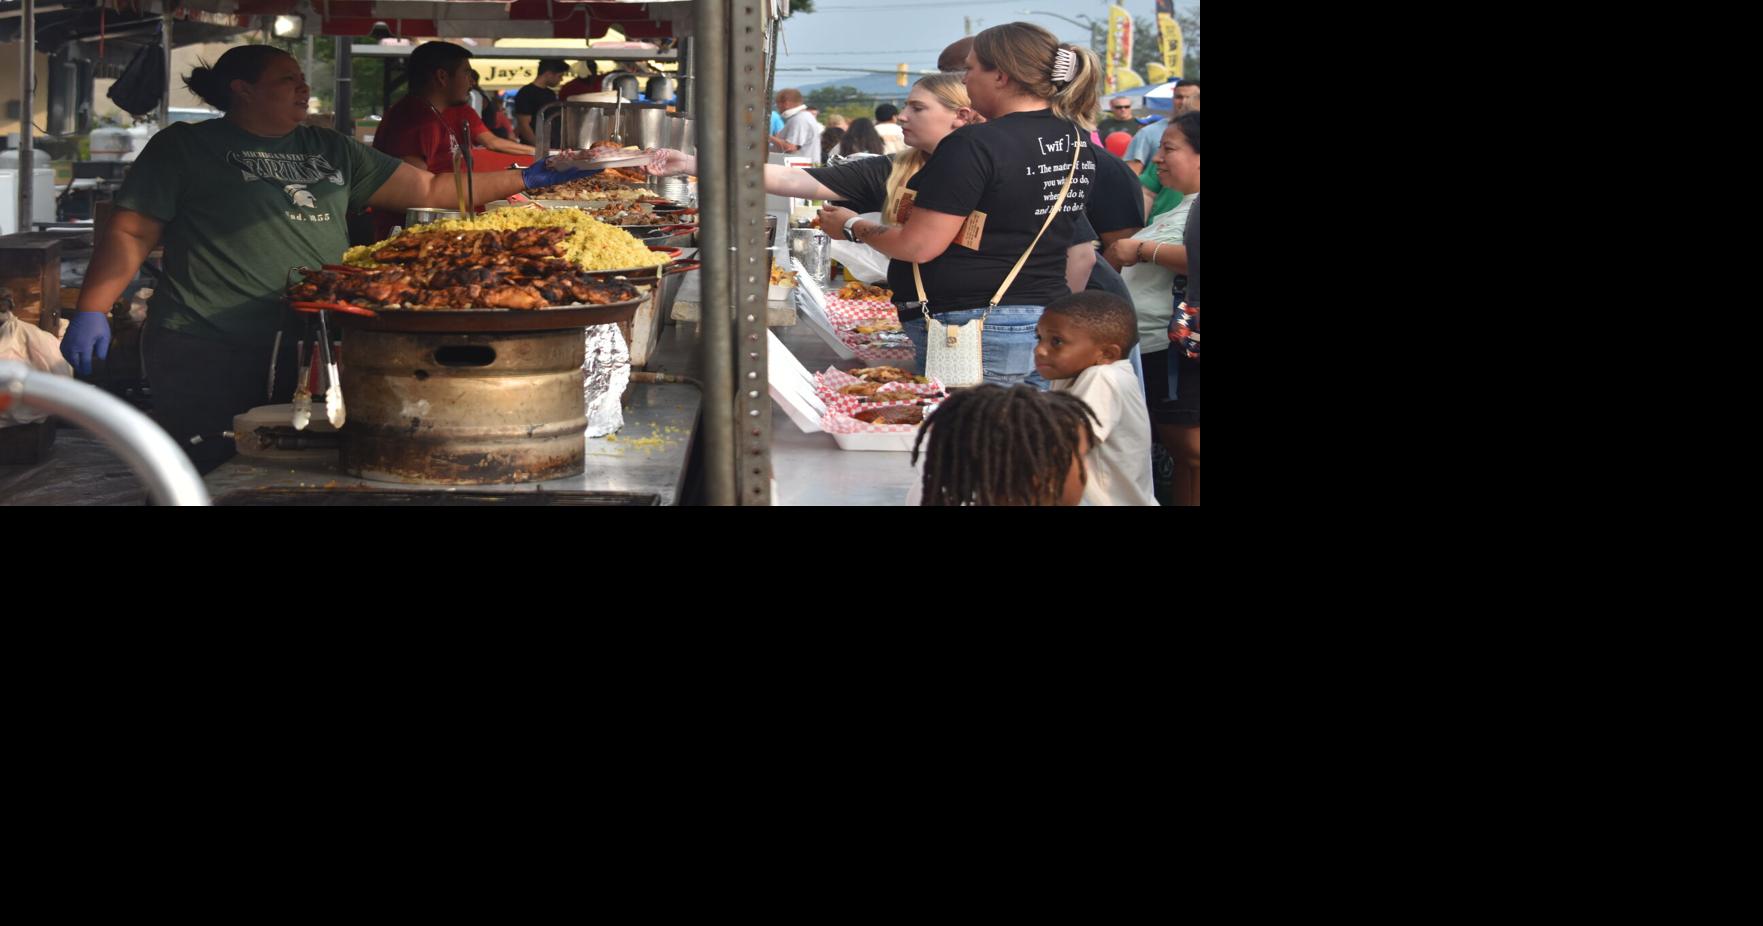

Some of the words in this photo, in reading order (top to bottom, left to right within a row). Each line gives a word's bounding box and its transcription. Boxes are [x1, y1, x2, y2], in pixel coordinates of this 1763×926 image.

[485, 66, 532, 81] Jay's
[287, 153, 305, 161] STAT
[1026, 166, 1035, 176] 1.
[1038, 164, 1052, 174] The
[1053, 163, 1074, 172] natur
[1043, 180, 1056, 190] you
[1067, 189, 1077, 198] do
[1063, 204, 1071, 212] to
